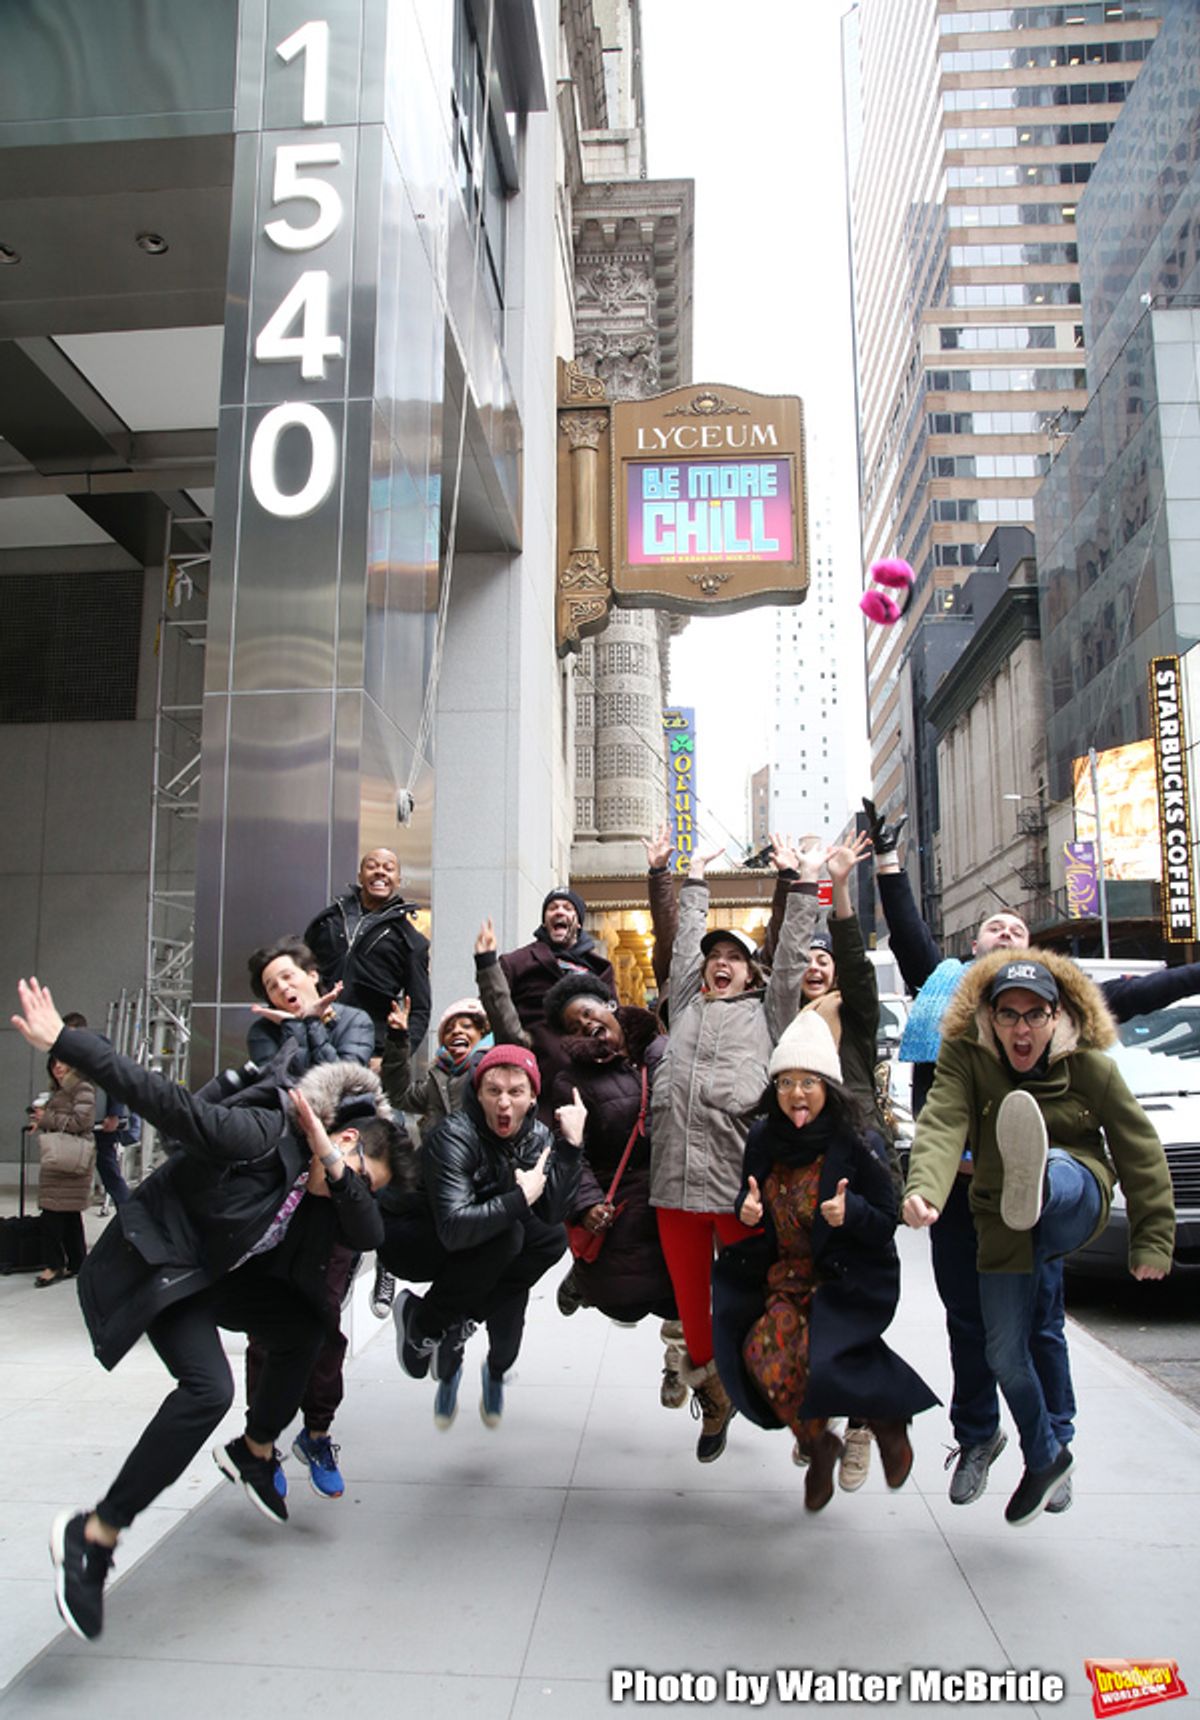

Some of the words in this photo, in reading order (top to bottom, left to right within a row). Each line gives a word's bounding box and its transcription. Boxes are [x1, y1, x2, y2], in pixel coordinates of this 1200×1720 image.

[249, 20, 345, 518] 1540
[637, 424, 778, 450] LYCEUM
[642, 467, 680, 499] BE
[688, 464, 777, 498] MORE
[1156, 669, 1186, 824] STARBUCKS
[1166, 829, 1192, 929] COFFEE
